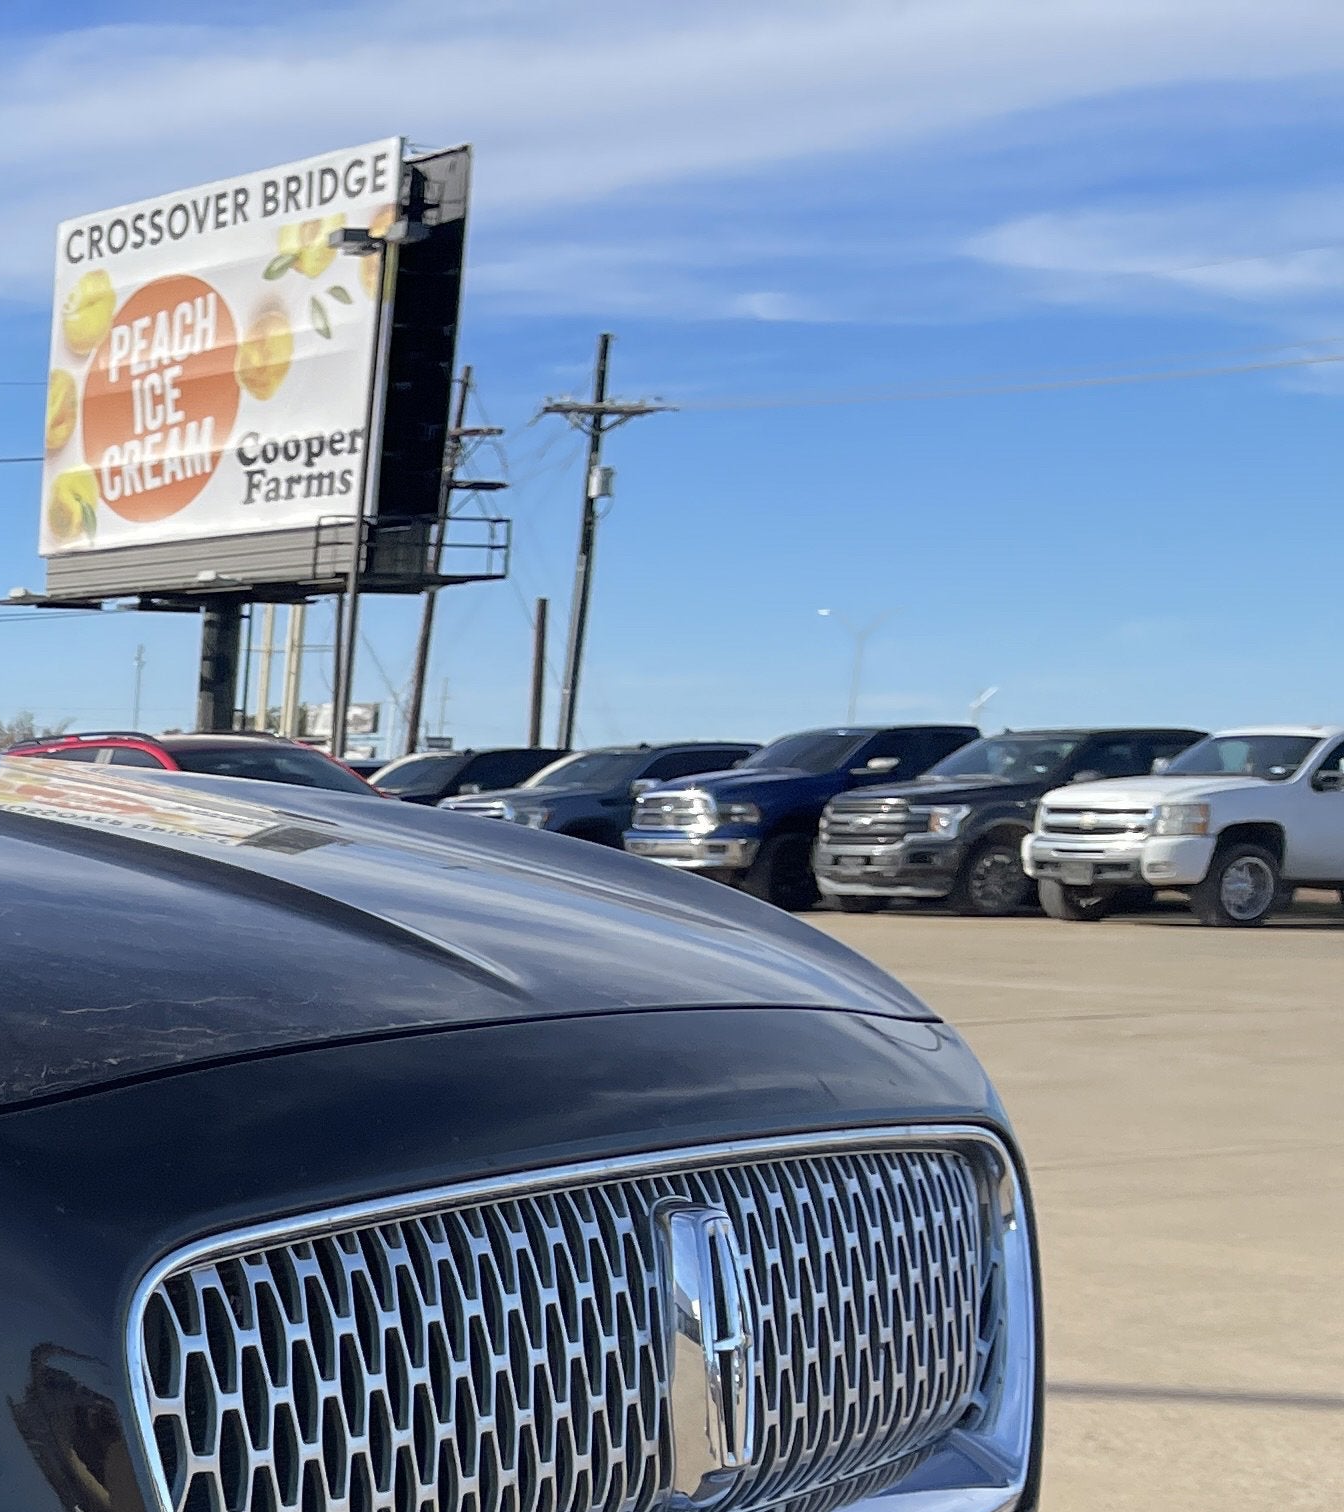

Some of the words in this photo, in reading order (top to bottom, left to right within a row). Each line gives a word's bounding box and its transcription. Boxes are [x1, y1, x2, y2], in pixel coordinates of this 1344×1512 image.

[66, 187, 248, 264] CROSSOVER
[262, 153, 388, 217] BRIDGE
[109, 293, 217, 383] PEACH
[132, 365, 185, 434] ICE
[101, 417, 215, 501] CREAM
[236, 428, 363, 467] Cooper
[243, 469, 353, 505] Farms
